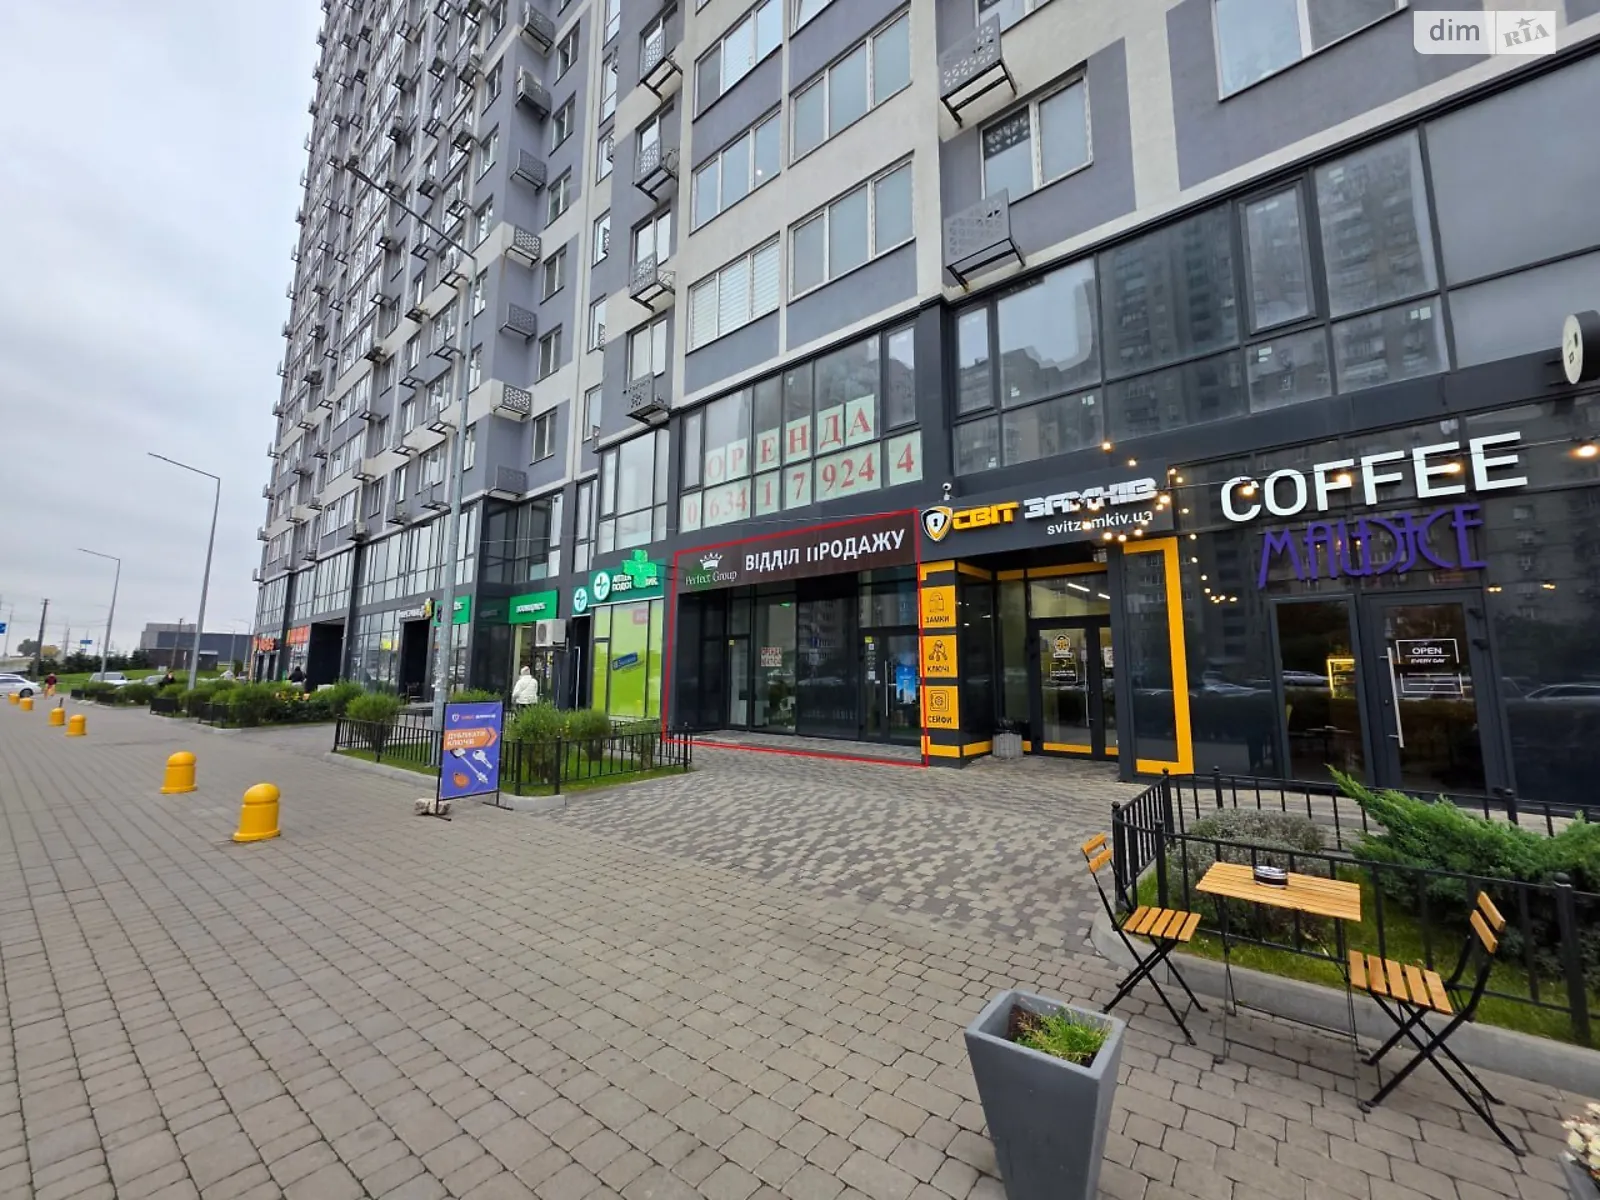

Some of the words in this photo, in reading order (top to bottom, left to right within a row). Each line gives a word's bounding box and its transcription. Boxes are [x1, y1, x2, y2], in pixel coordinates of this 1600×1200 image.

[707, 408, 872, 479] ОРЕНДА
[1220, 431, 1528, 522] COFFEE
[953, 501, 1020, 530] СВІТ
[1046, 510, 1154, 535] svitzmkiv.ua
[745, 548, 800, 573] ВІДДІЛ
[712, 570, 737, 582] Group
[926, 615, 950, 623] ЗАМКИ
[928, 715, 952, 724] СЕЙФИ
